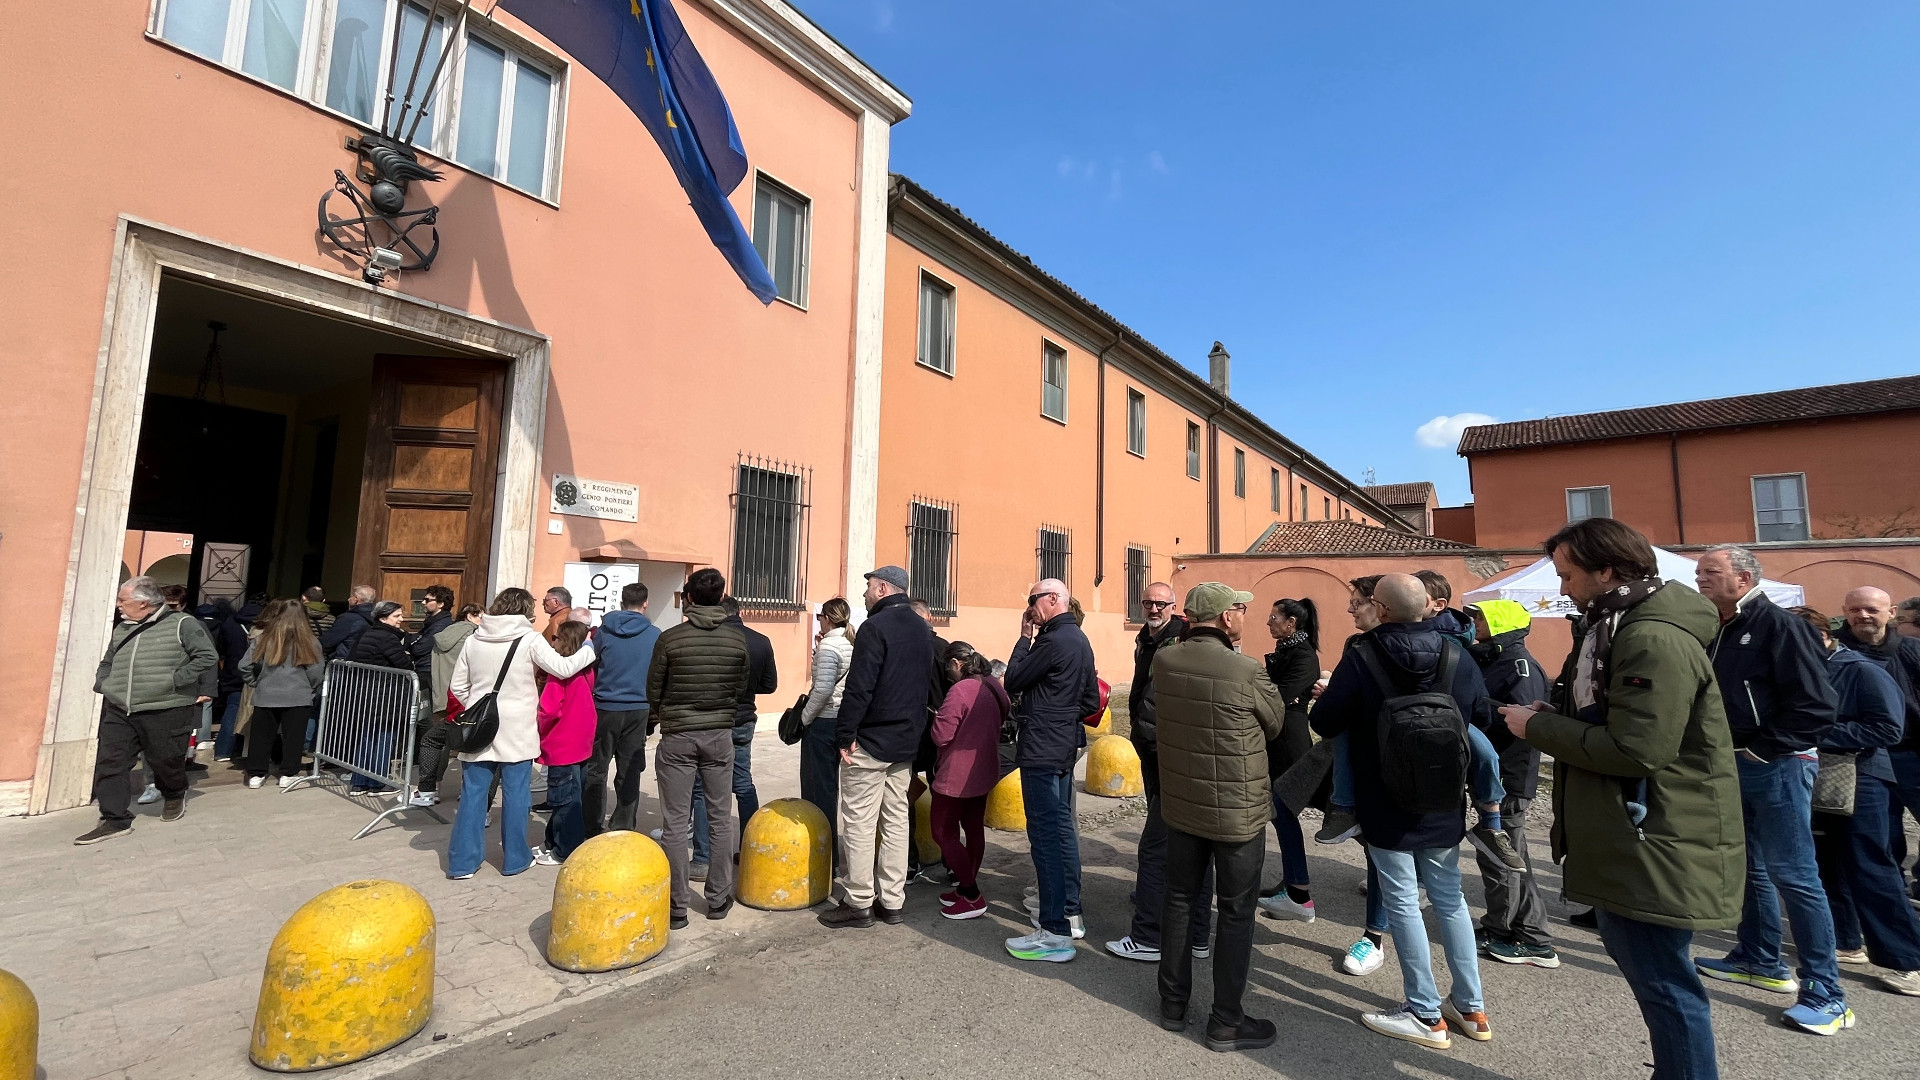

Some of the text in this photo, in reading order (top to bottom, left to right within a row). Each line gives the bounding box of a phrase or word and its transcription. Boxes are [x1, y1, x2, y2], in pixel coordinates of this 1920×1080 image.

[592, 484, 633, 496] REGGIMENTO
[581, 493, 633, 506] GENIO PONTIERI
[590, 505, 624, 514] COMANDO
[587, 573, 609, 617] ITO
